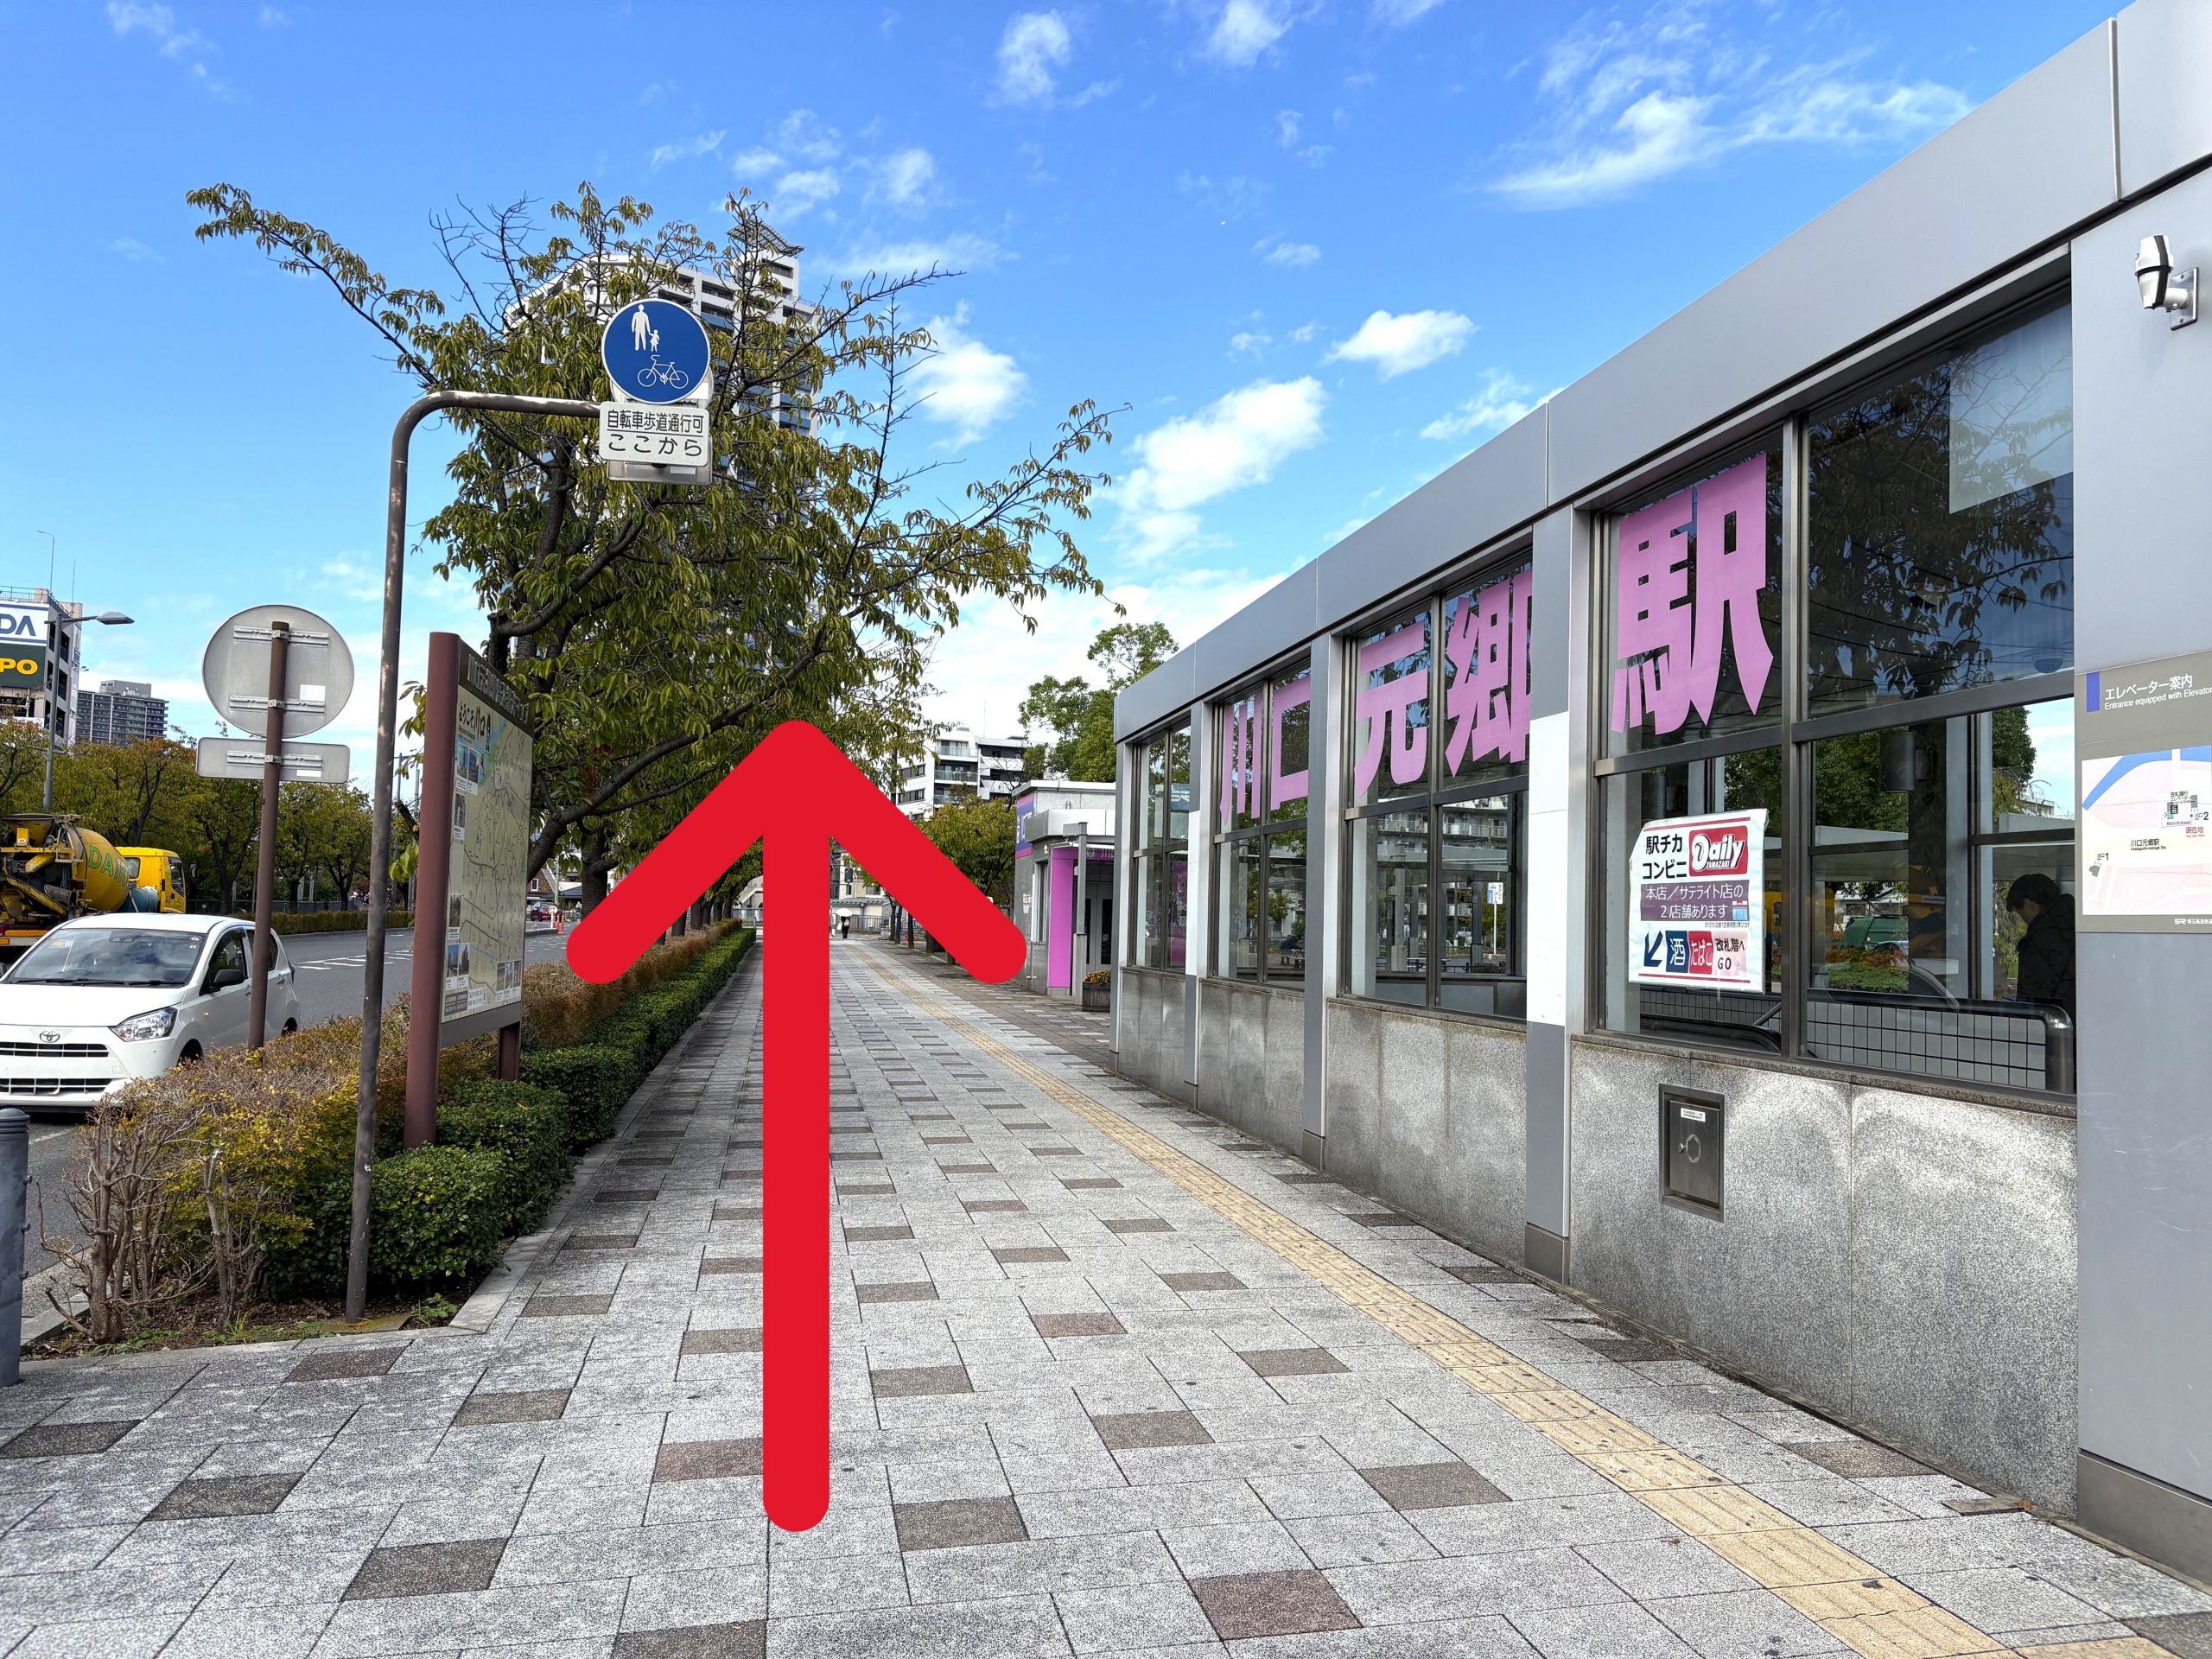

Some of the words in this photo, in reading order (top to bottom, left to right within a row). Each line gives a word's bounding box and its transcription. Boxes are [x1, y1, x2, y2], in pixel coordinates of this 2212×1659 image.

[607, 409, 704, 433] 自転車歩道通行可
[608, 434, 702, 456] ここから
[2105, 674, 2193, 701] エレベーター案内
[2105, 699, 2133, 710] Entrance
[2135, 694, 2166, 705] equipped
[2168, 691, 2182, 700] with
[2203, 811, 2209, 821] 2
[1645, 834, 1682, 855] 駅チカ
[1692, 834, 1745, 872] Daily
[1643, 860, 1687, 879] コンビニ
[1661, 904, 1728, 919] 2店舗あります
[1669, 938, 1686, 966] 酒
[1715, 938, 1745, 952] 改札階へ
[1718, 957, 1732, 970] GO
